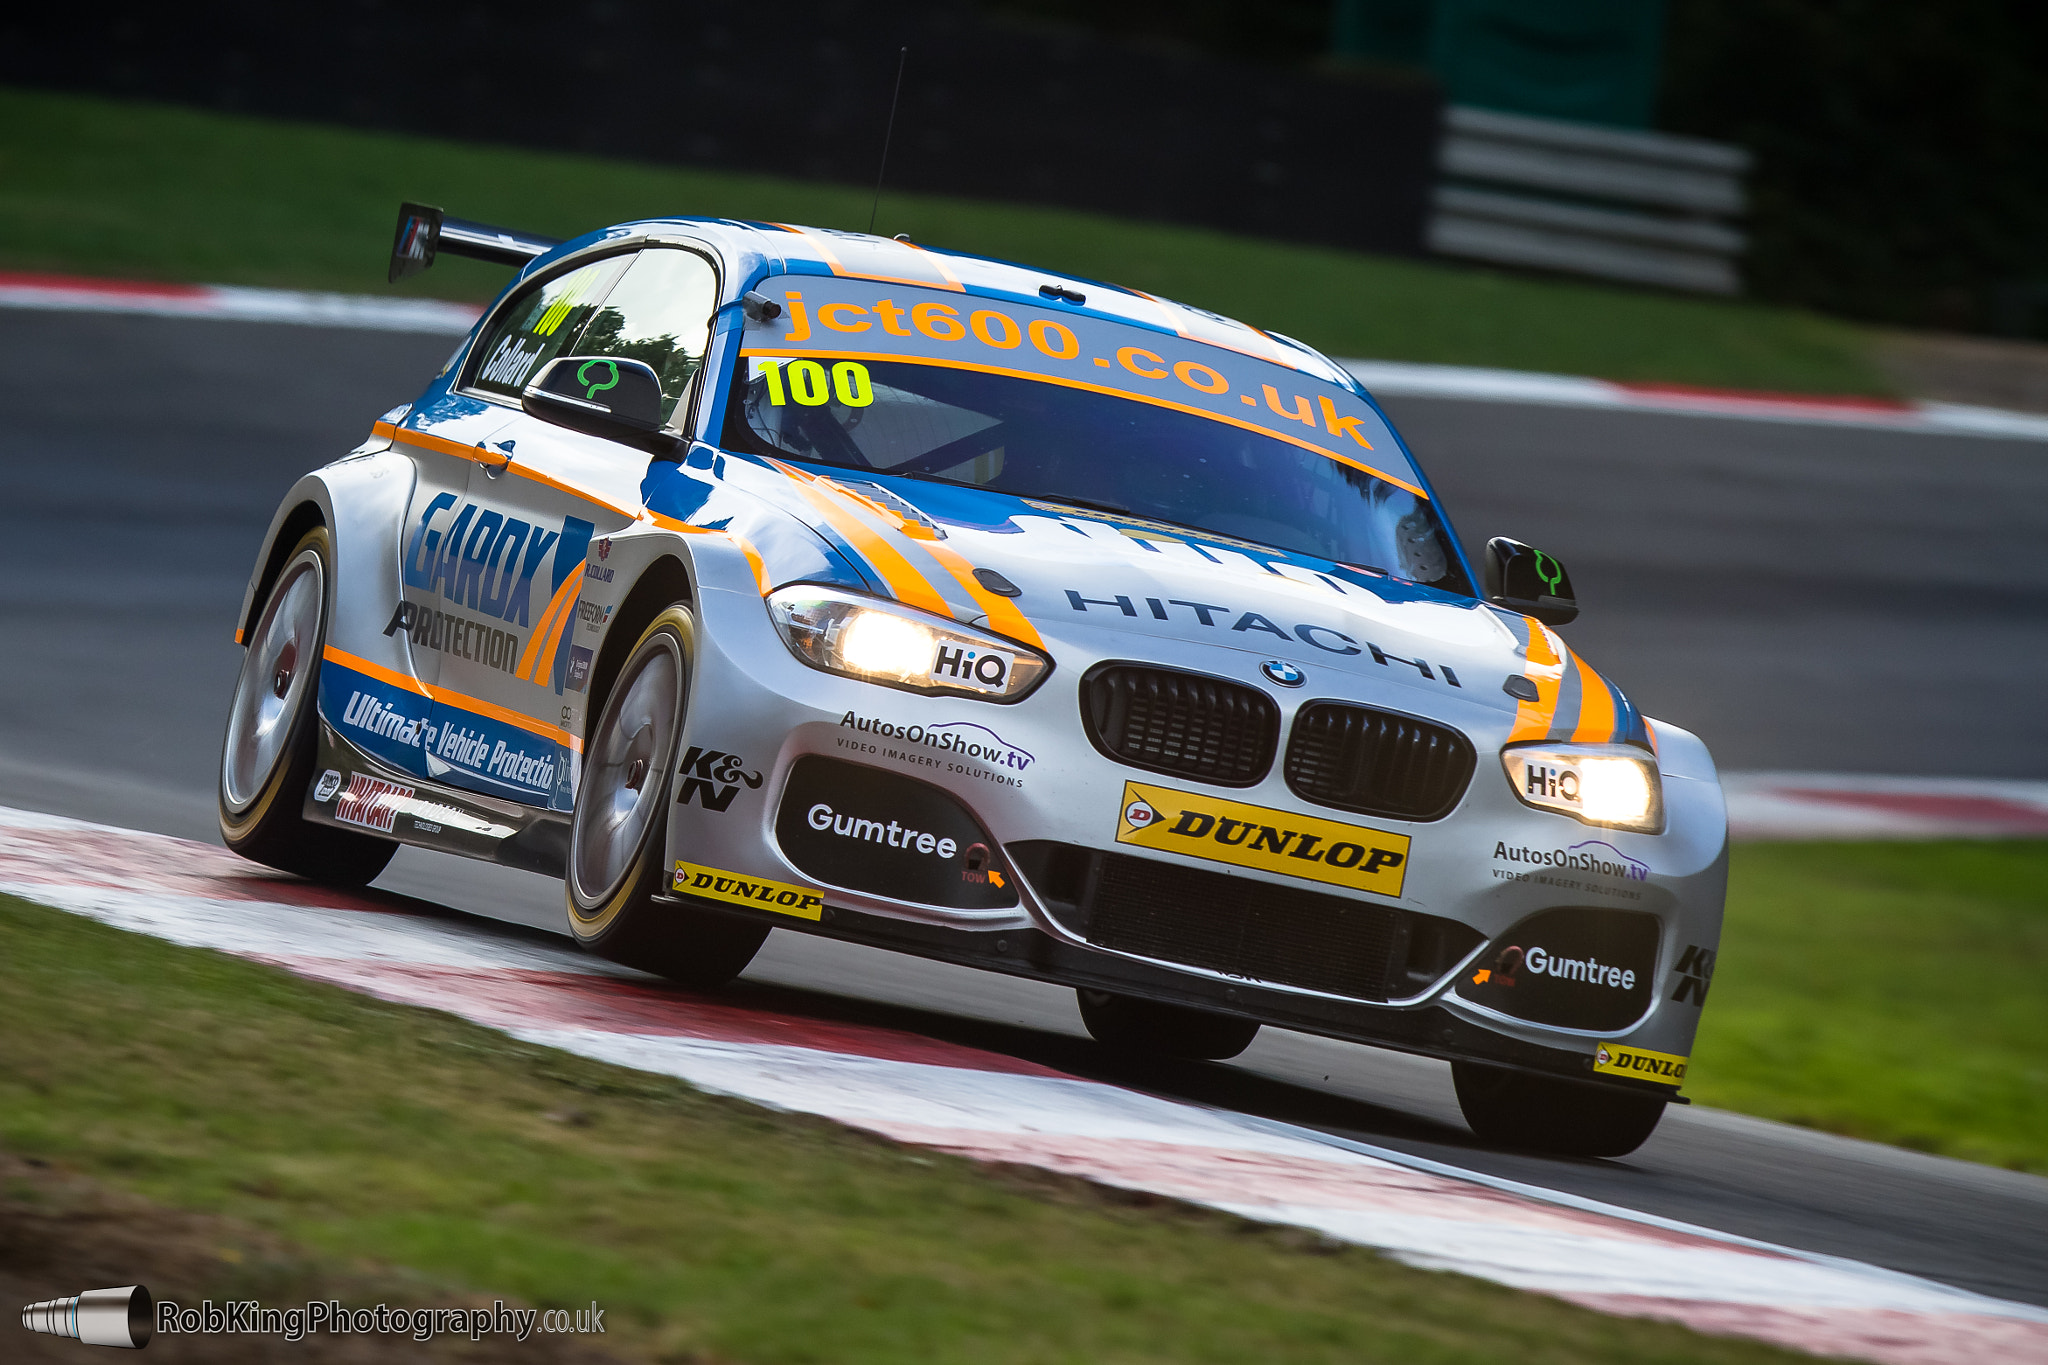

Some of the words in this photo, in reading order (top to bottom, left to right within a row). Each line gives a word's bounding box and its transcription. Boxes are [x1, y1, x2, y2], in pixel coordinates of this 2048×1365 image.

[481, 334, 546, 387] Collard
[758, 360, 874, 407] 100
[785, 291, 1374, 451] jct600.co.uk
[405, 491, 560, 628] GARDX
[383, 600, 519, 674] PROTECTION
[1064, 589, 1462, 688] HITACHI
[934, 646, 1006, 688] HiQ
[343, 691, 437, 751] Ultimate
[436, 721, 489, 768] Vehicle
[487, 740, 555, 790] Protectio
[836, 737, 877, 754] VIDEO
[882, 747, 942, 769] IMAGERY
[947, 762, 1024, 788] SOLUTIONS
[839, 710, 1030, 771] AutosOnShow.tv
[1527, 764, 1582, 802] HiQ
[807, 803, 957, 858] Gumtree
[1167, 810, 1404, 874] DUNLOP
[961, 870, 986, 884] TOW
[1492, 869, 1530, 882] VIDEO
[1534, 875, 1581, 890] IMAGERY
[1585, 883, 1641, 900] SOLUTIONS
[1493, 841, 1648, 882] AutosOnShow.tv
[690, 872, 822, 910] DUNLOP
[1525, 946, 1636, 990] Gumtree
[1613, 1052, 1687, 1079] DUNLO
